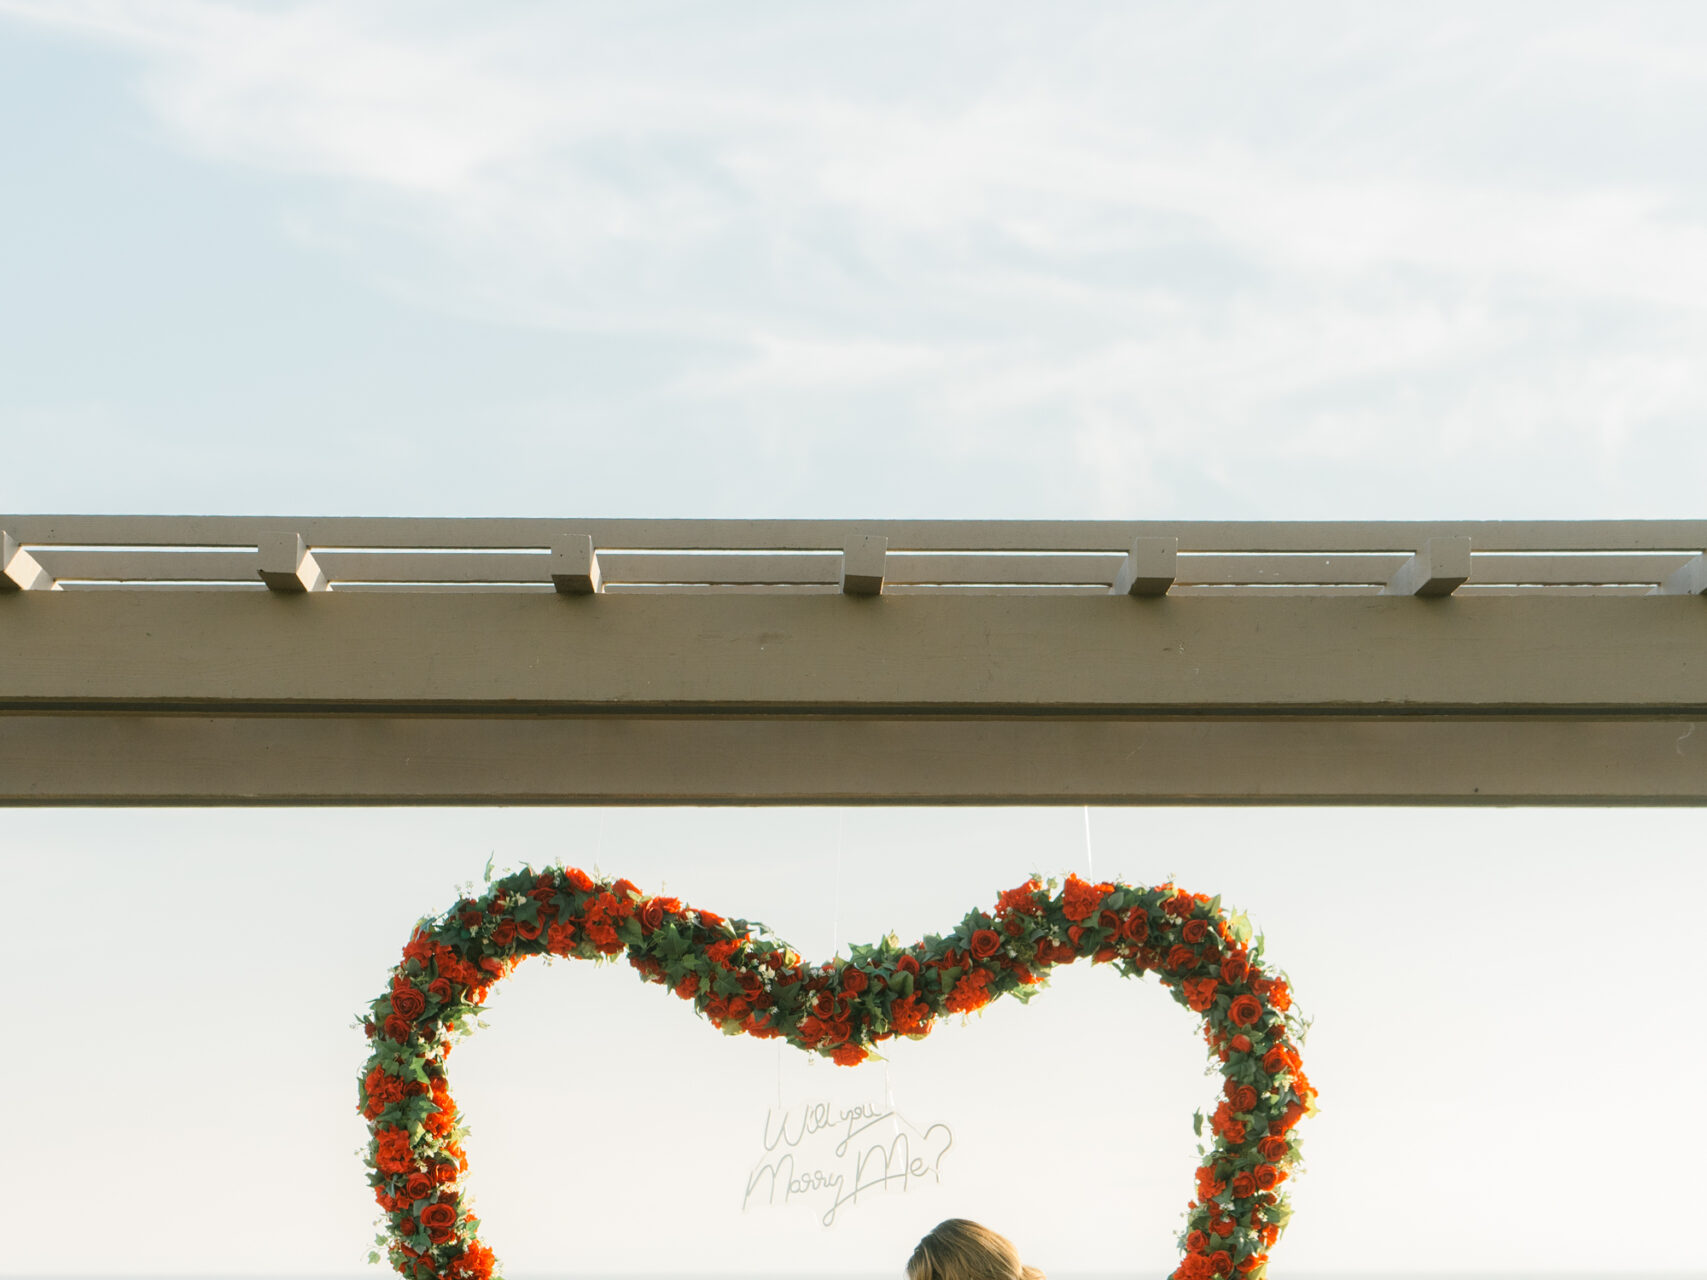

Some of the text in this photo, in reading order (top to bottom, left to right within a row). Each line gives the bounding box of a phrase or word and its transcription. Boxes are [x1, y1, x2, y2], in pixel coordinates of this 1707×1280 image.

[763, 1102, 895, 1158] Will you
[741, 1123, 953, 1227] Marry Me?
